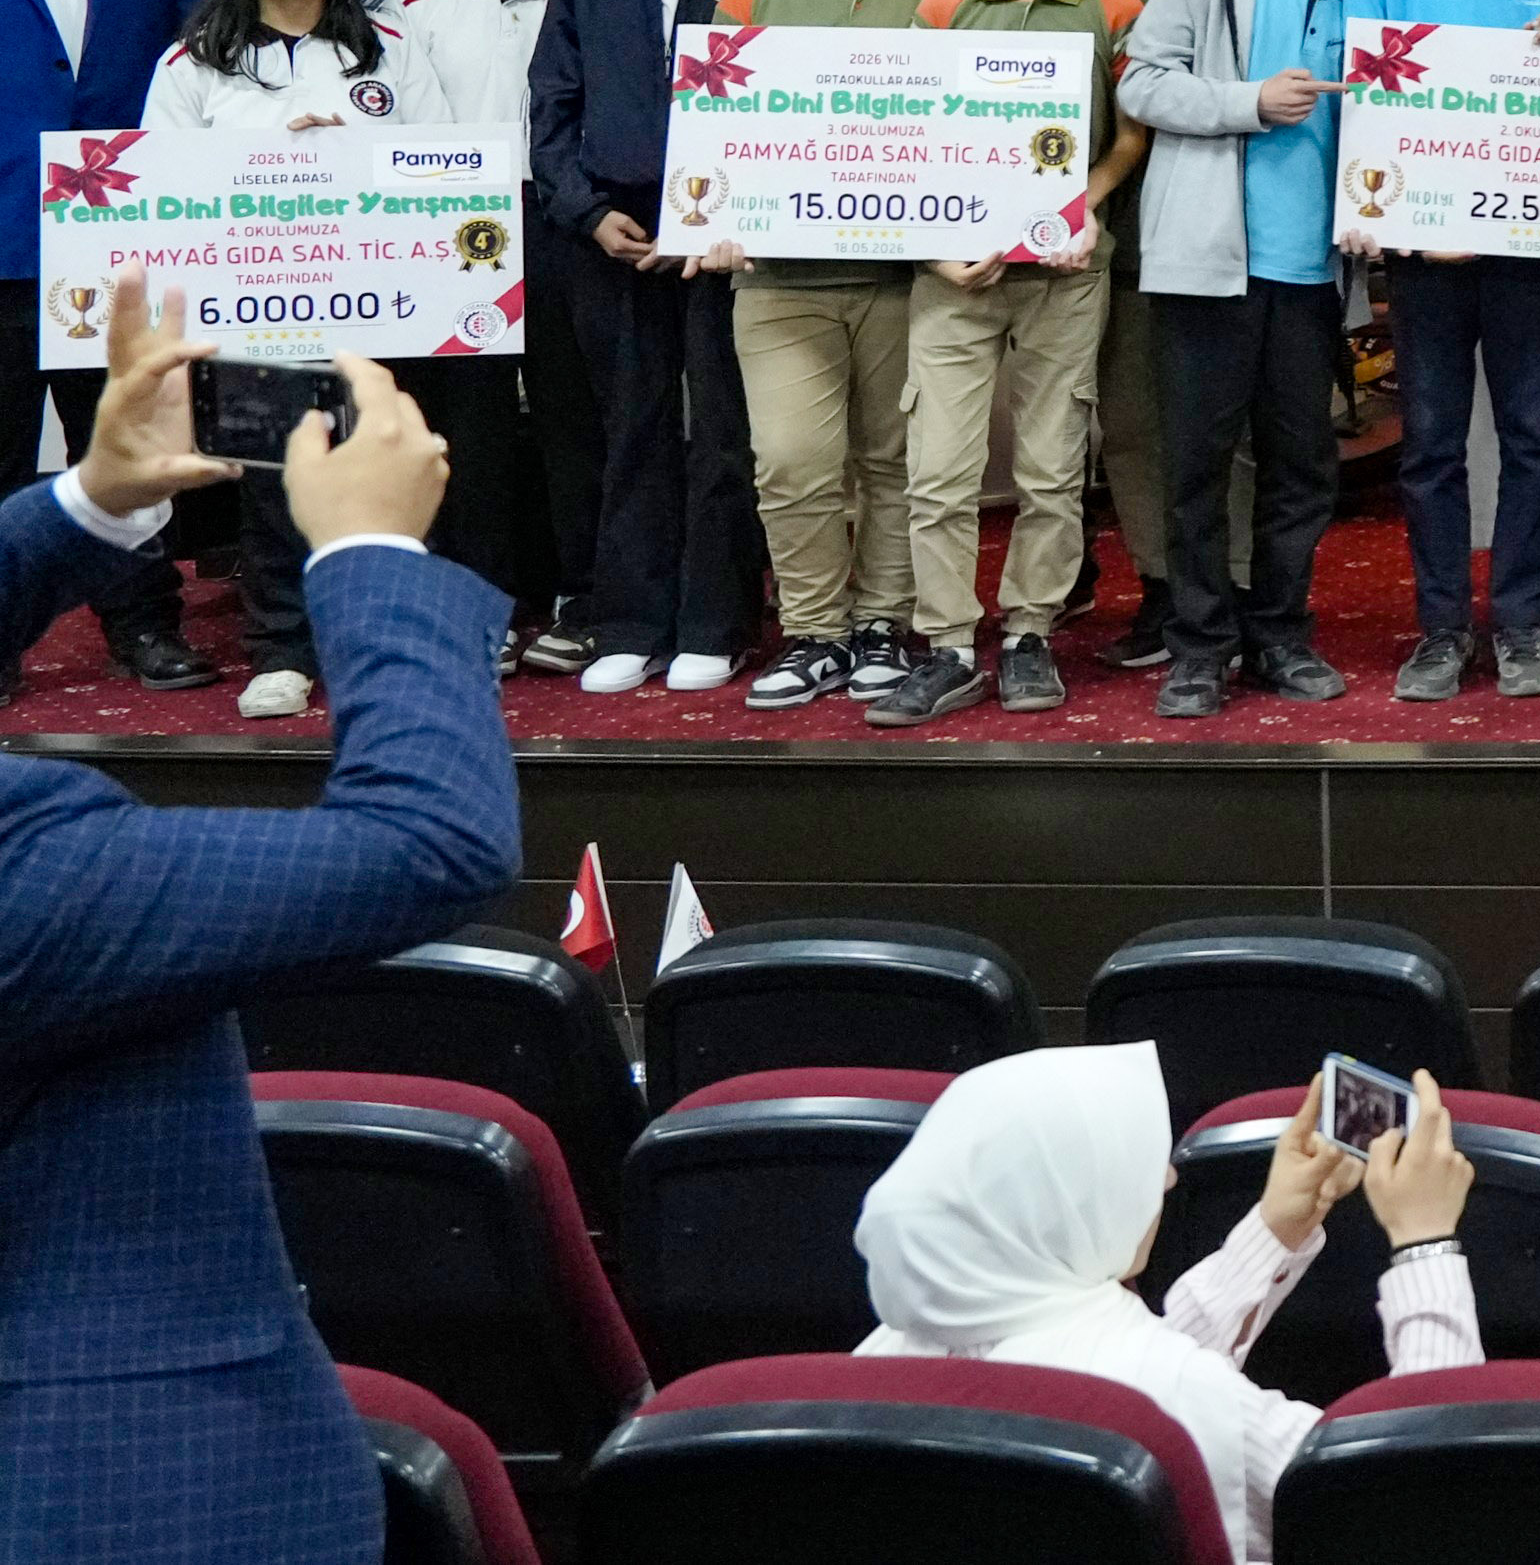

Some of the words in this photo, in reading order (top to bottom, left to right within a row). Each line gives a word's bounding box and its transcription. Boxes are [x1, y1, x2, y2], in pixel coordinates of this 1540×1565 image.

[849, 54, 883, 65] 2026
[887, 55, 910, 65] YILI
[976, 55, 1057, 76] Pamyağ
[816, 74, 903, 87] ORTAOKULLAR
[906, 75, 942, 87] ARASI
[674, 89, 760, 114] Temel
[769, 90, 823, 114] Dini
[831, 89, 936, 119] Bilgiler
[942, 94, 1080, 123] Yarışması
[1347, 82, 1434, 109] Temel
[1441, 87, 1496, 115] Dini
[828, 125, 838, 135] 3.
[842, 125, 925, 136] OKULUMUZA
[248, 153, 284, 165] 2026
[290, 152, 318, 164] YILI
[724, 139, 817, 161] PAMYAĞ
[825, 144, 875, 162] GIDA
[1399, 137, 1491, 161] PAMYAĞ
[392, 148, 483, 171] Pamyağ
[234, 173, 288, 186] LİSELER
[292, 173, 333, 184] ARASI
[831, 171, 916, 184] TARAFINDAN
[46, 200, 148, 224] Temel
[157, 195, 221, 220] Dini
[230, 194, 348, 222] Bilgiler
[357, 192, 512, 220] Yarışması
[227, 245, 284, 265] GIDA
[236, 273, 333, 285] TARAFINDAN
[200, 292, 380, 325] 6.000.00
[244, 344, 325, 357] 18.05.2026
